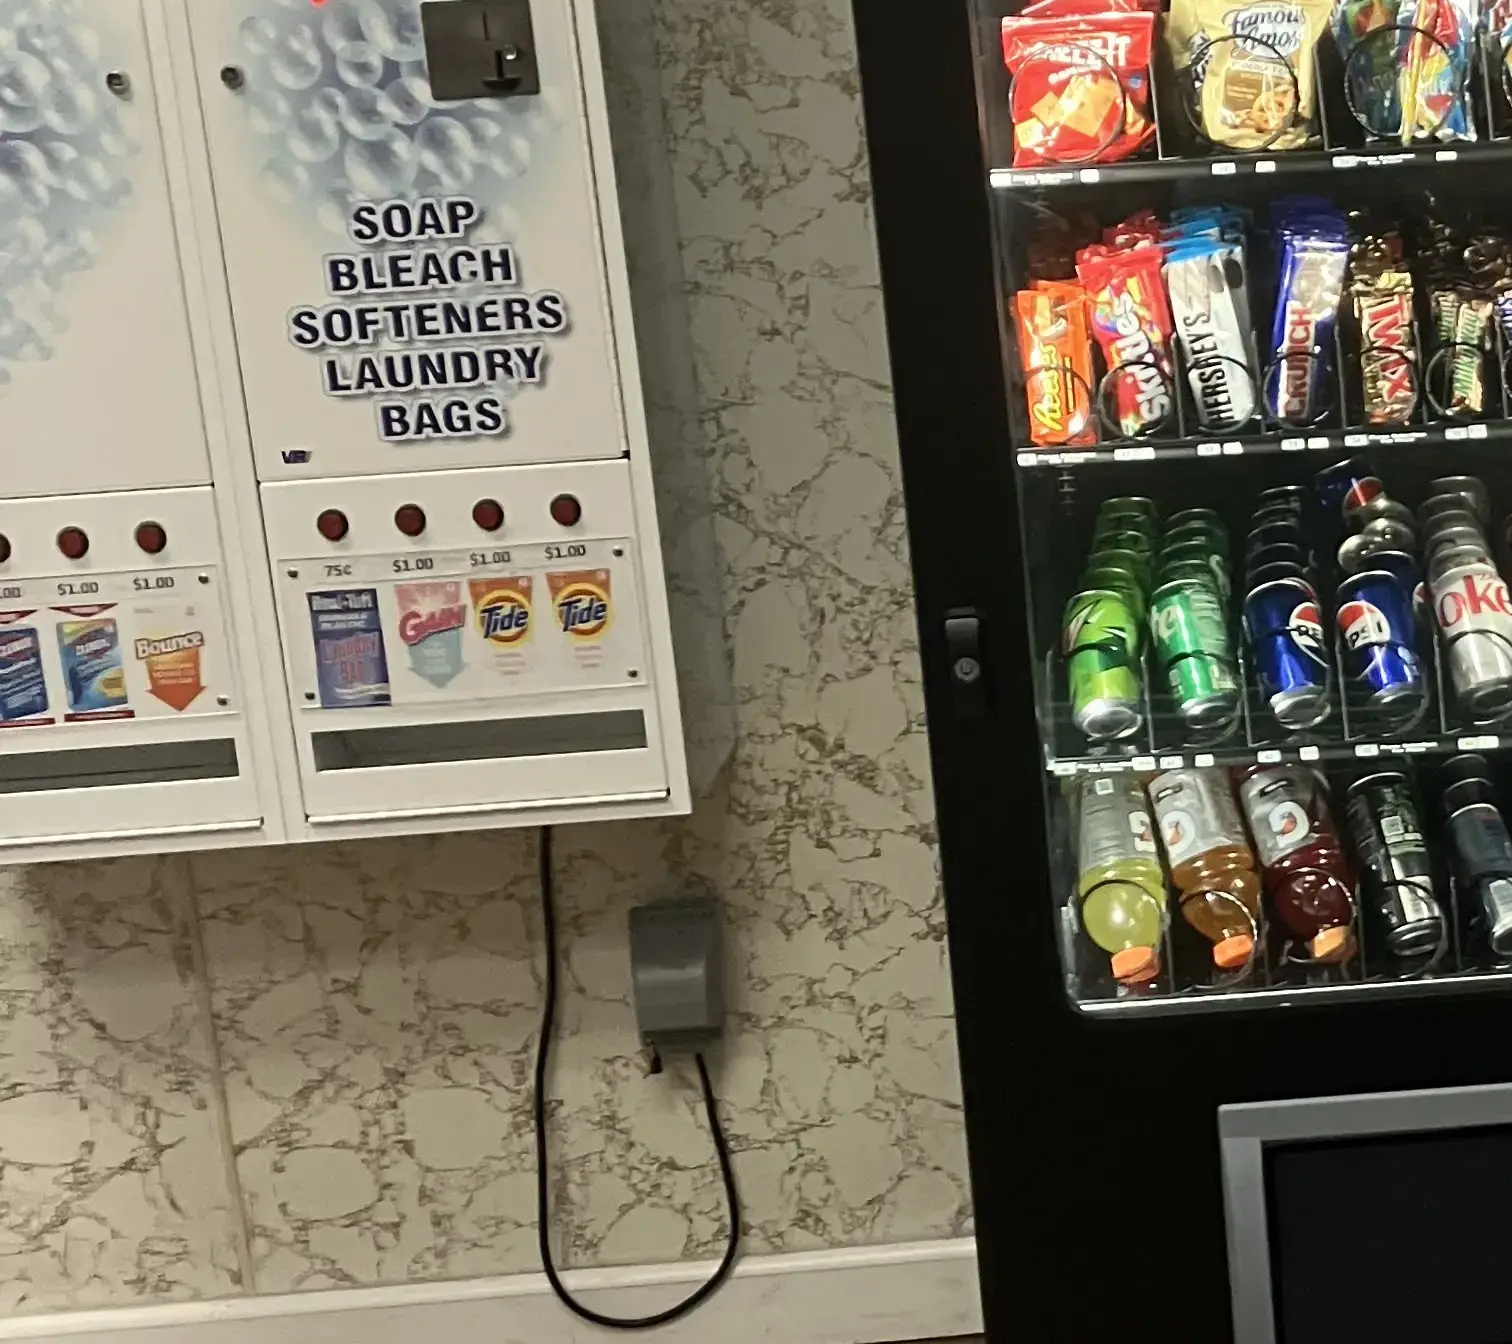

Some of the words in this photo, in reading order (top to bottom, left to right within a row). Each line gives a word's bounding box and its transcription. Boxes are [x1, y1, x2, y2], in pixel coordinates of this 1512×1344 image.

[351, 197, 477, 242] SOAP
[328, 248, 514, 294] BLEACH
[291, 294, 565, 344] SOFTENERS
[1183, 312, 1235, 424] HERSHEY'S
[1284, 304, 1313, 419] CRUNCH
[1368, 295, 1414, 403] TWIX
[324, 345, 543, 394] LAUNDRY
[380, 397, 504, 438] BAGS
[393, 557, 433, 572] $1.00
[470, 551, 511, 567] $1.00
[545, 544, 586, 560] $1.00
[57, 581, 99, 596] $1.00
[133, 576, 175, 590] $1.00
[480, 604, 530, 639] Tide
[558, 597, 608, 633] Tide
[136, 632, 205, 659] Bounce
